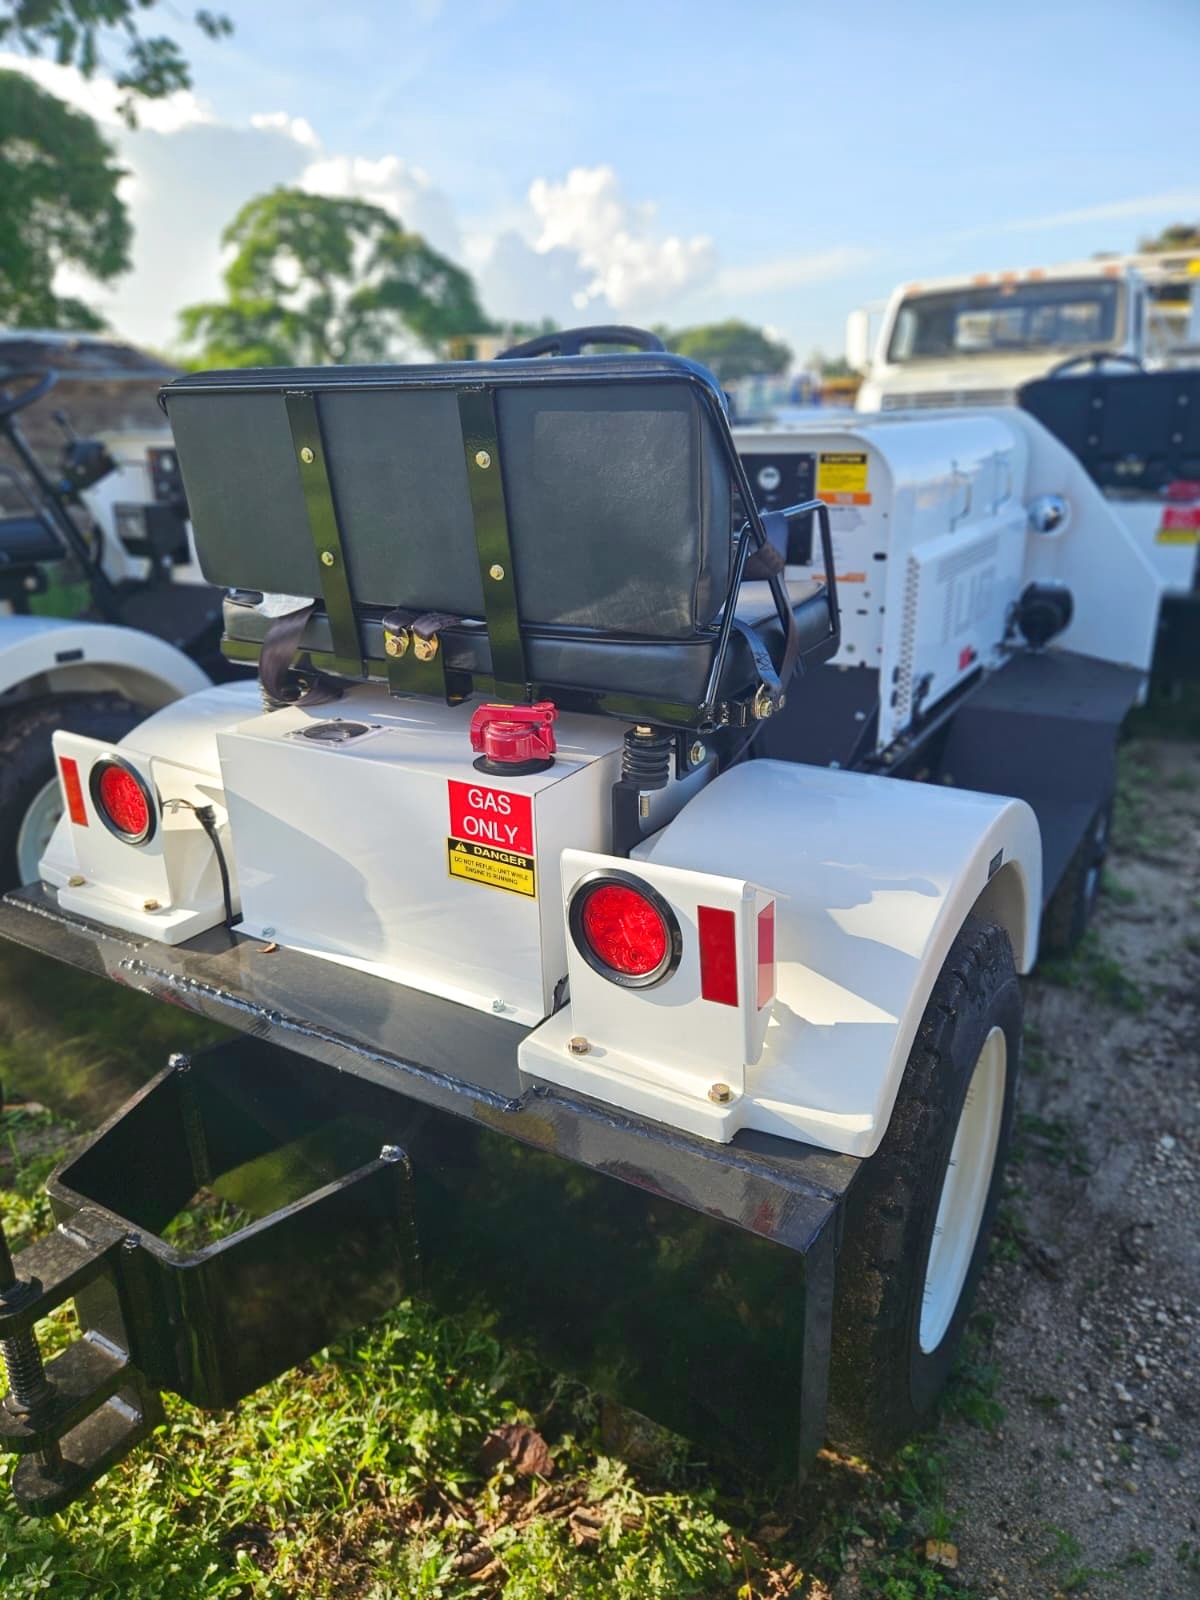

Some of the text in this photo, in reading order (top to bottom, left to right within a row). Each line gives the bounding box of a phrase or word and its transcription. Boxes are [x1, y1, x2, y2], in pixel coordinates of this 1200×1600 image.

[468, 788, 511, 815] GAS
[463, 815, 518, 844] ONLY
[454, 856, 463, 864] DO
[475, 862, 497, 873] REFUEL
[497, 868, 510, 876] UNIT
[510, 871, 528, 881] WHILE
[473, 846, 527, 867] DANGER
[465, 866, 485, 876] ENGINE
[492, 874, 518, 886] RUNNING
